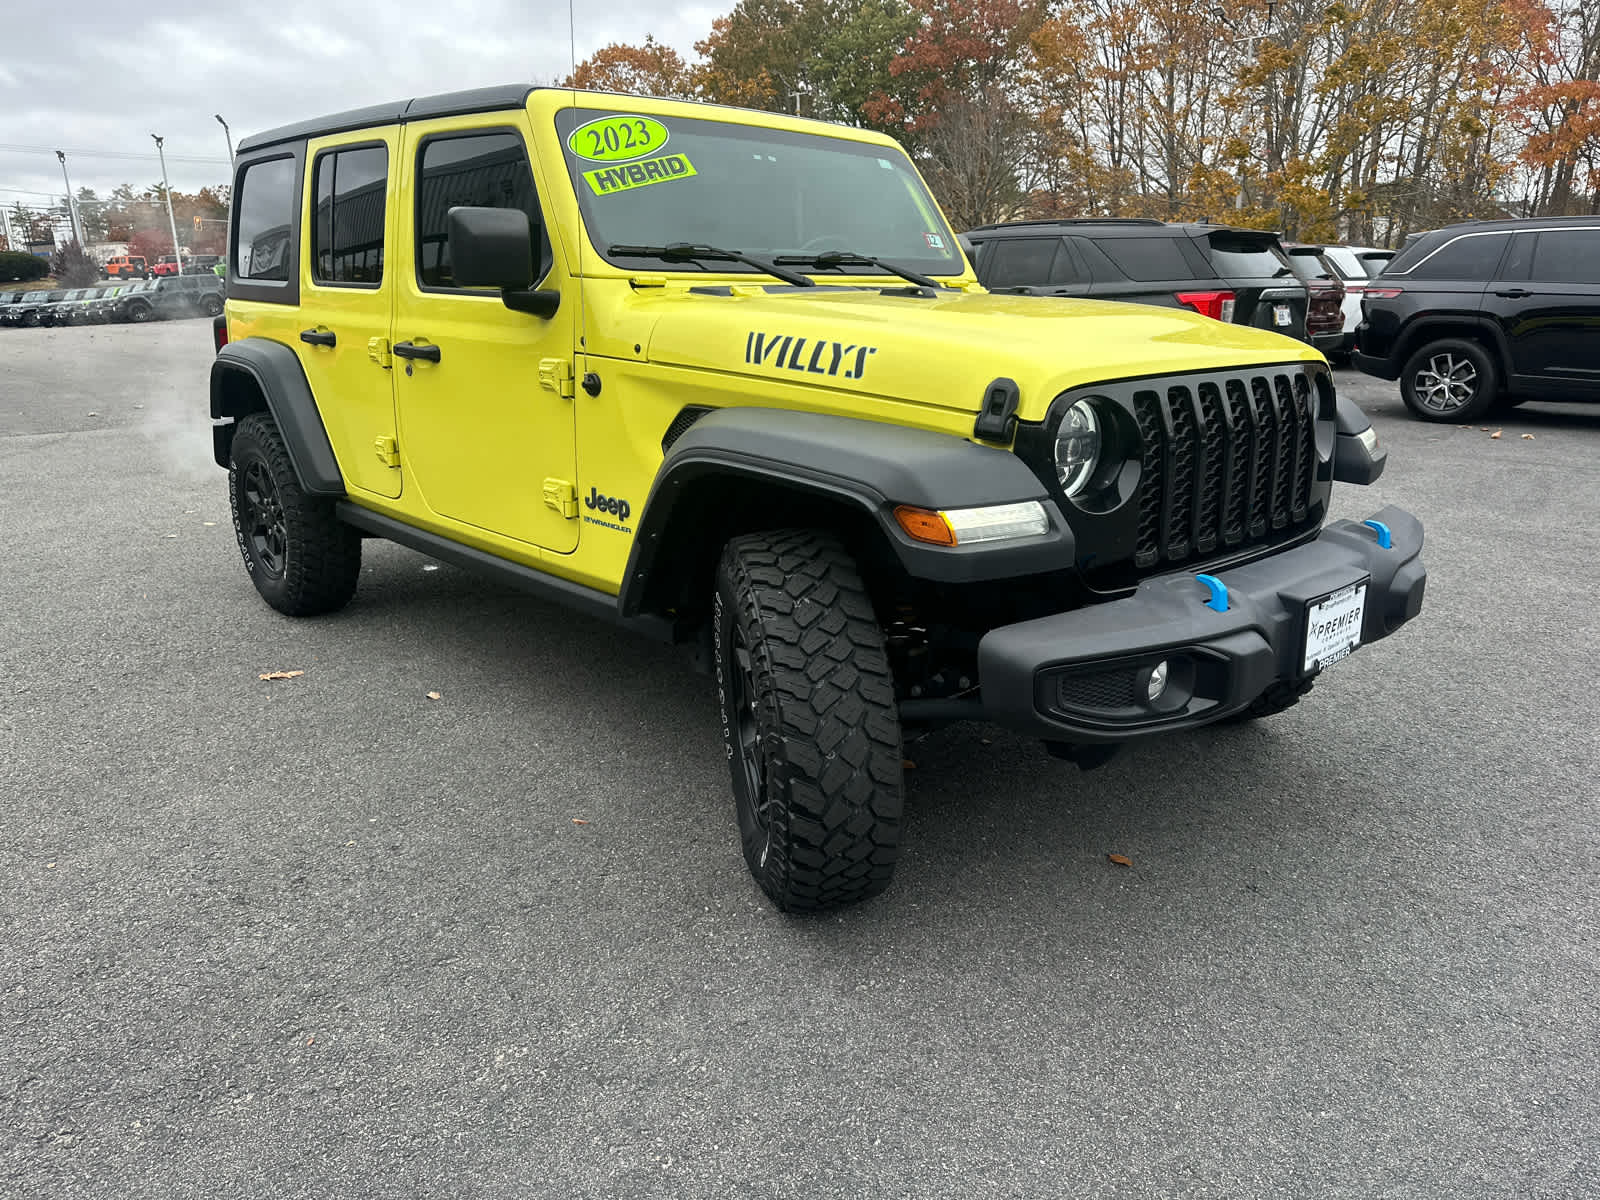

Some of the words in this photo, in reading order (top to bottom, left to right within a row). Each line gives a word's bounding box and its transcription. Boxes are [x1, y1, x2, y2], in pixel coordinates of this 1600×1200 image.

[587, 120, 651, 156] 2023
[594, 156, 687, 192] HYBRID
[745, 331, 877, 379] WILLYS
[585, 487, 631, 522] Jeep
[1317, 607, 1361, 640] PREMIER
[1319, 646, 1351, 671] PREMIER
